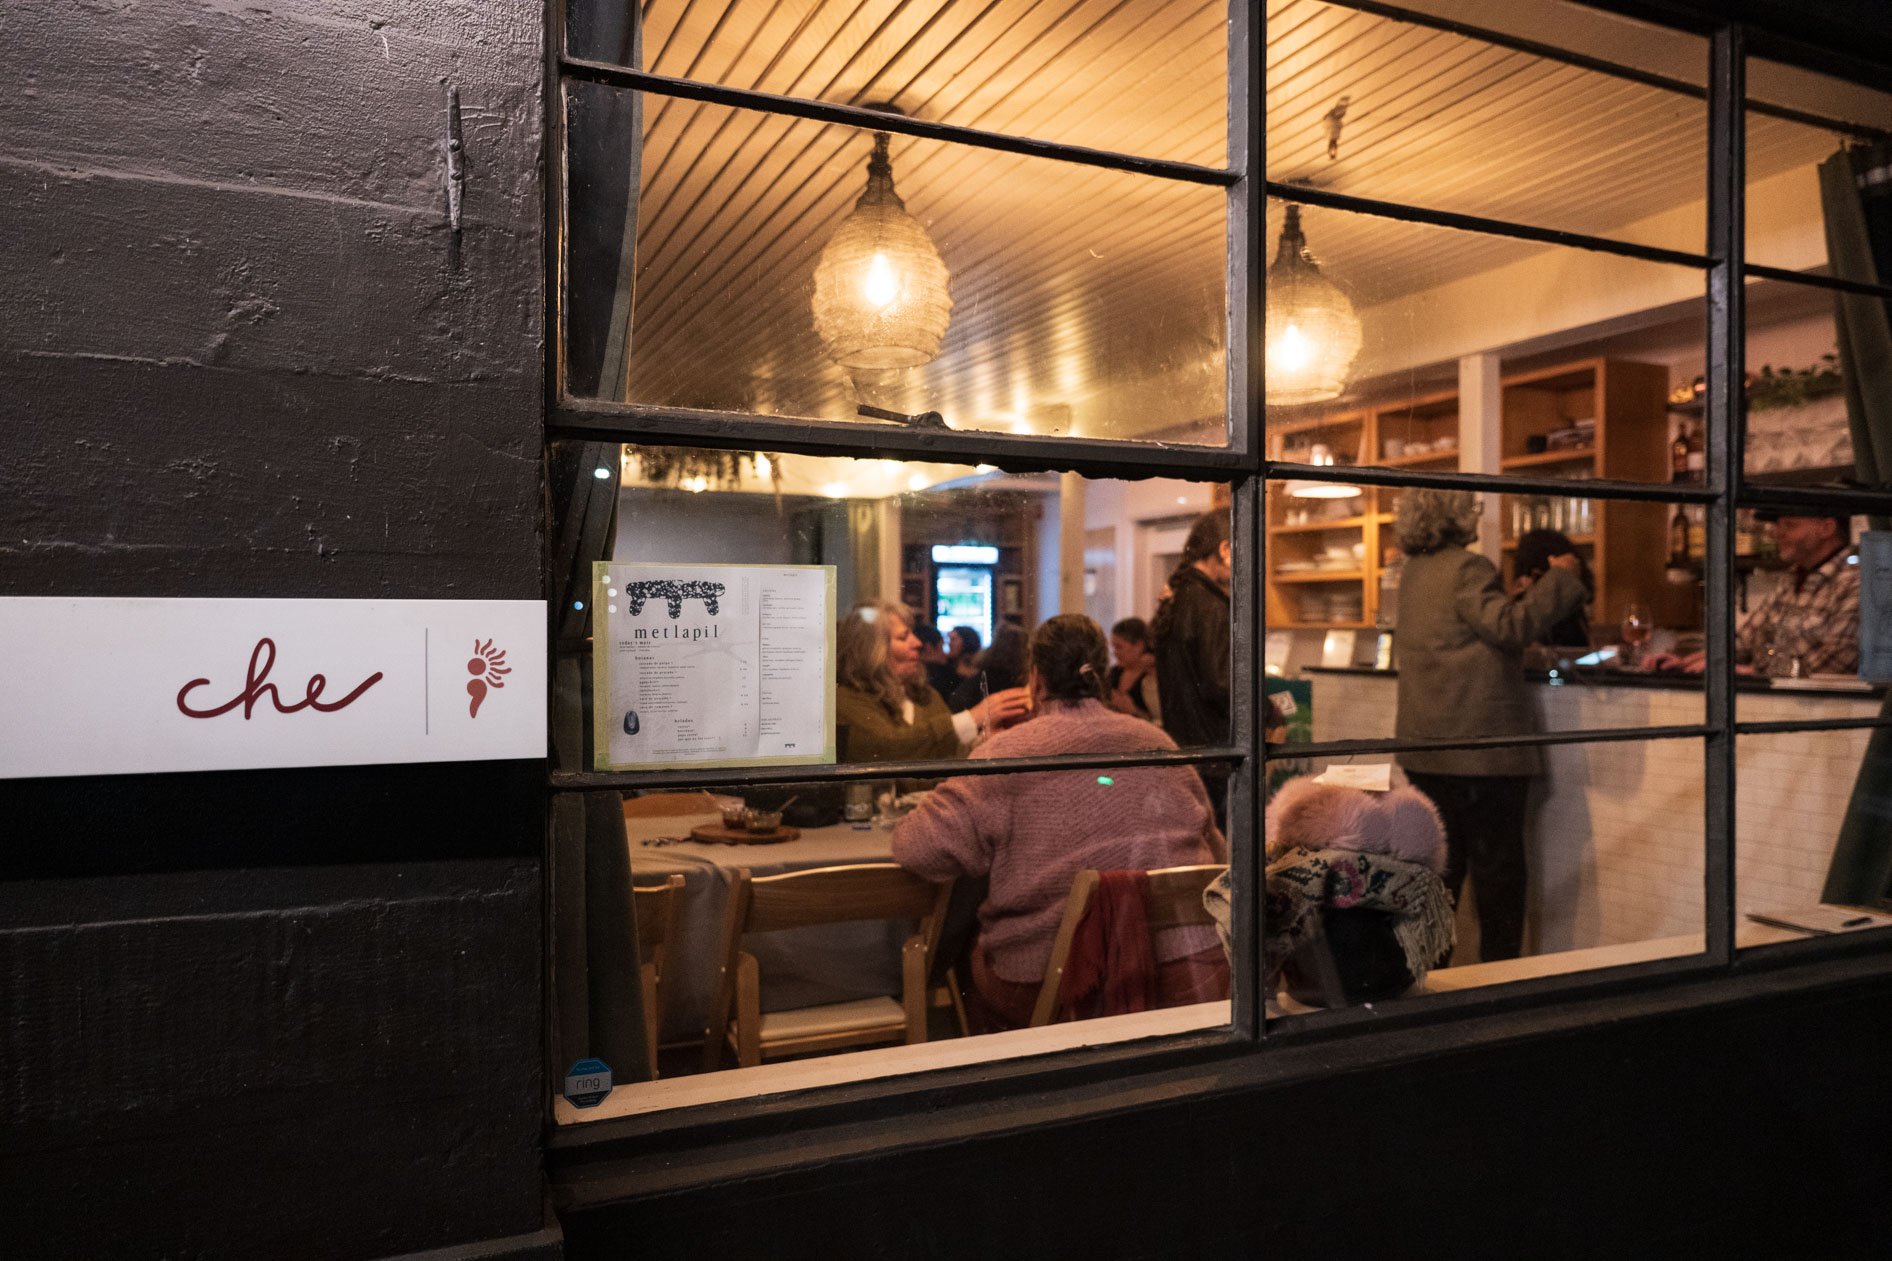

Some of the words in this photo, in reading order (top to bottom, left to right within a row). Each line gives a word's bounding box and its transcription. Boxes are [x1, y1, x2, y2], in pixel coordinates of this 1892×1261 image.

[634, 625, 718, 641] metlapil
[177, 637, 383, 720] che
[576, 1077, 600, 1091] ring
